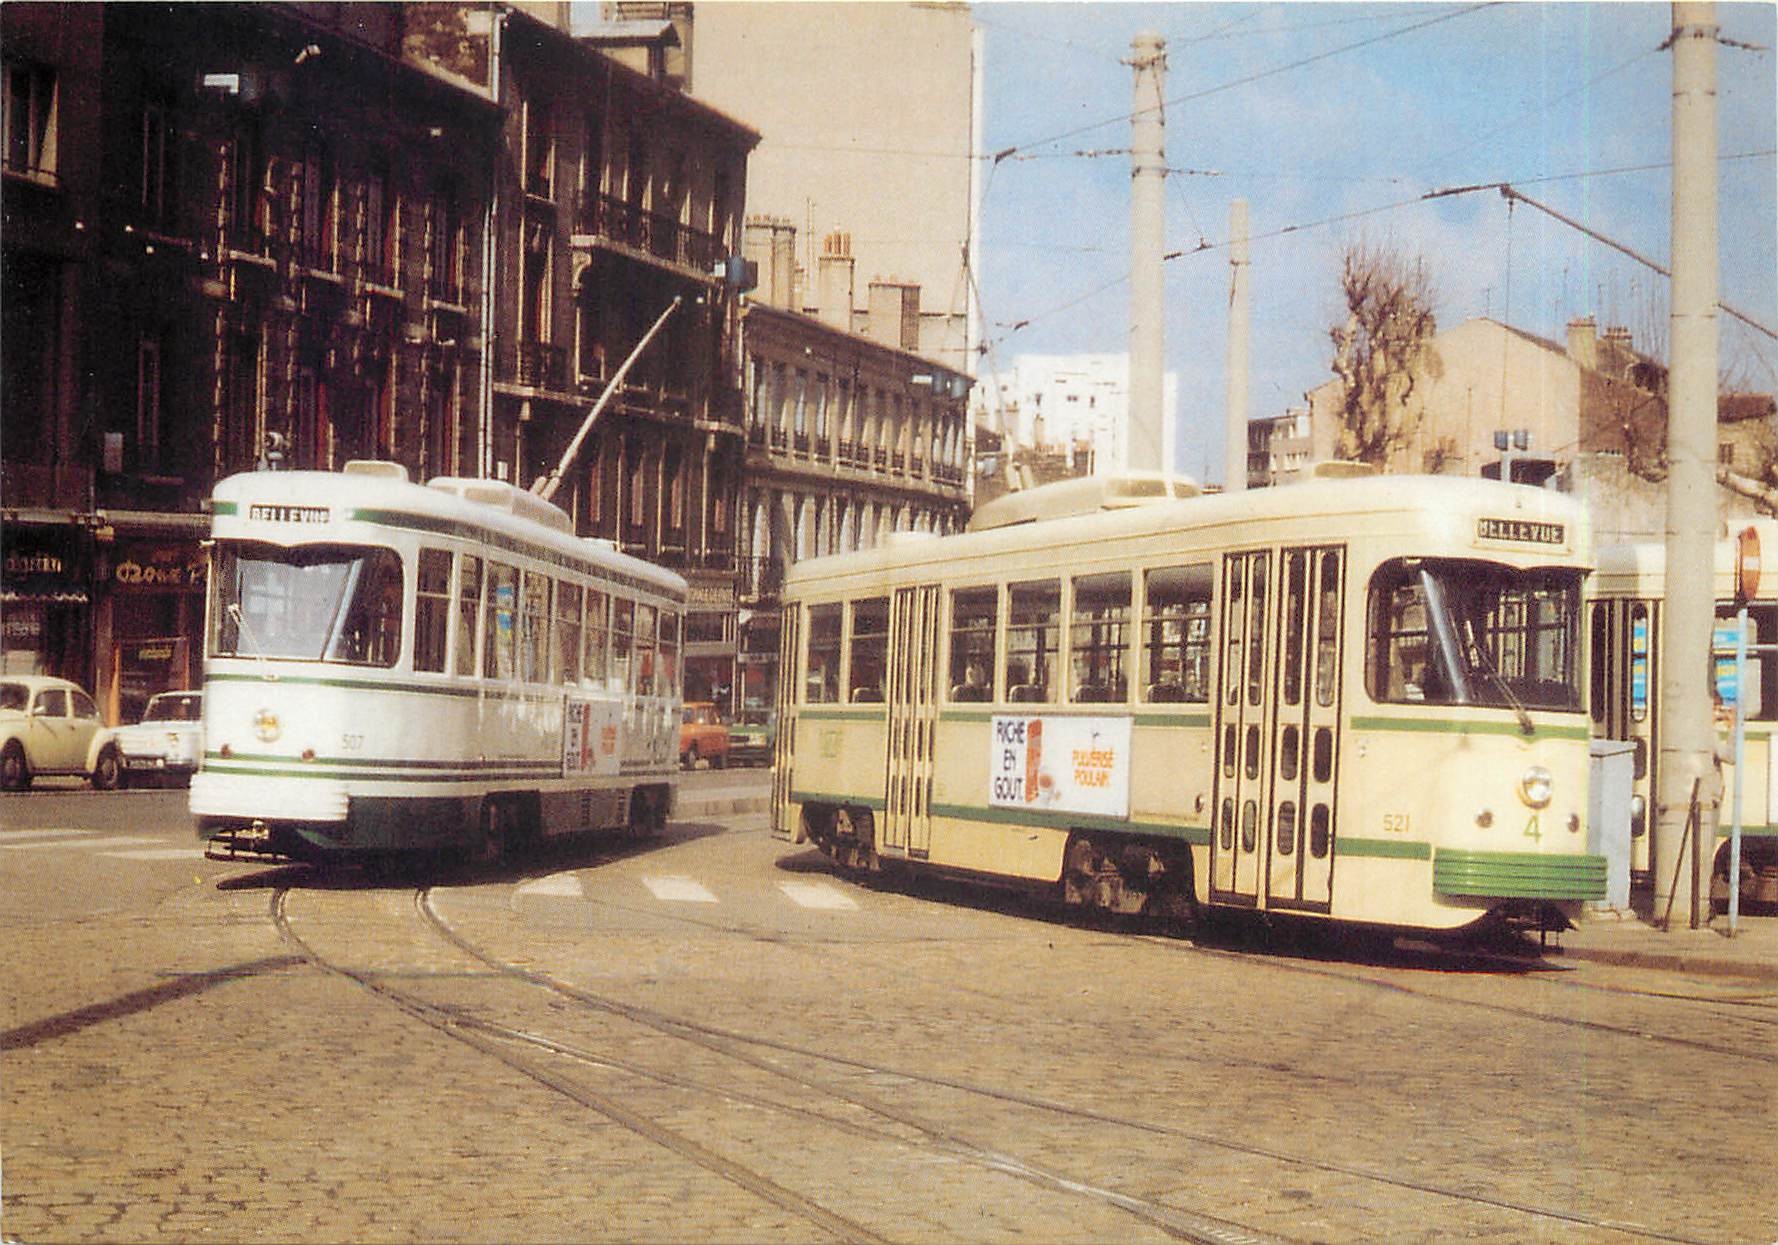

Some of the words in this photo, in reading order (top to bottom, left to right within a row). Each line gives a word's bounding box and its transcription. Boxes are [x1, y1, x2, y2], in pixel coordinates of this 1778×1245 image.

[1480, 520, 1563, 542] BELLEVUE
[1003, 748, 1016, 771] EN
[1383, 814, 1411, 832] 521
[1523, 814, 1542, 844] 4
